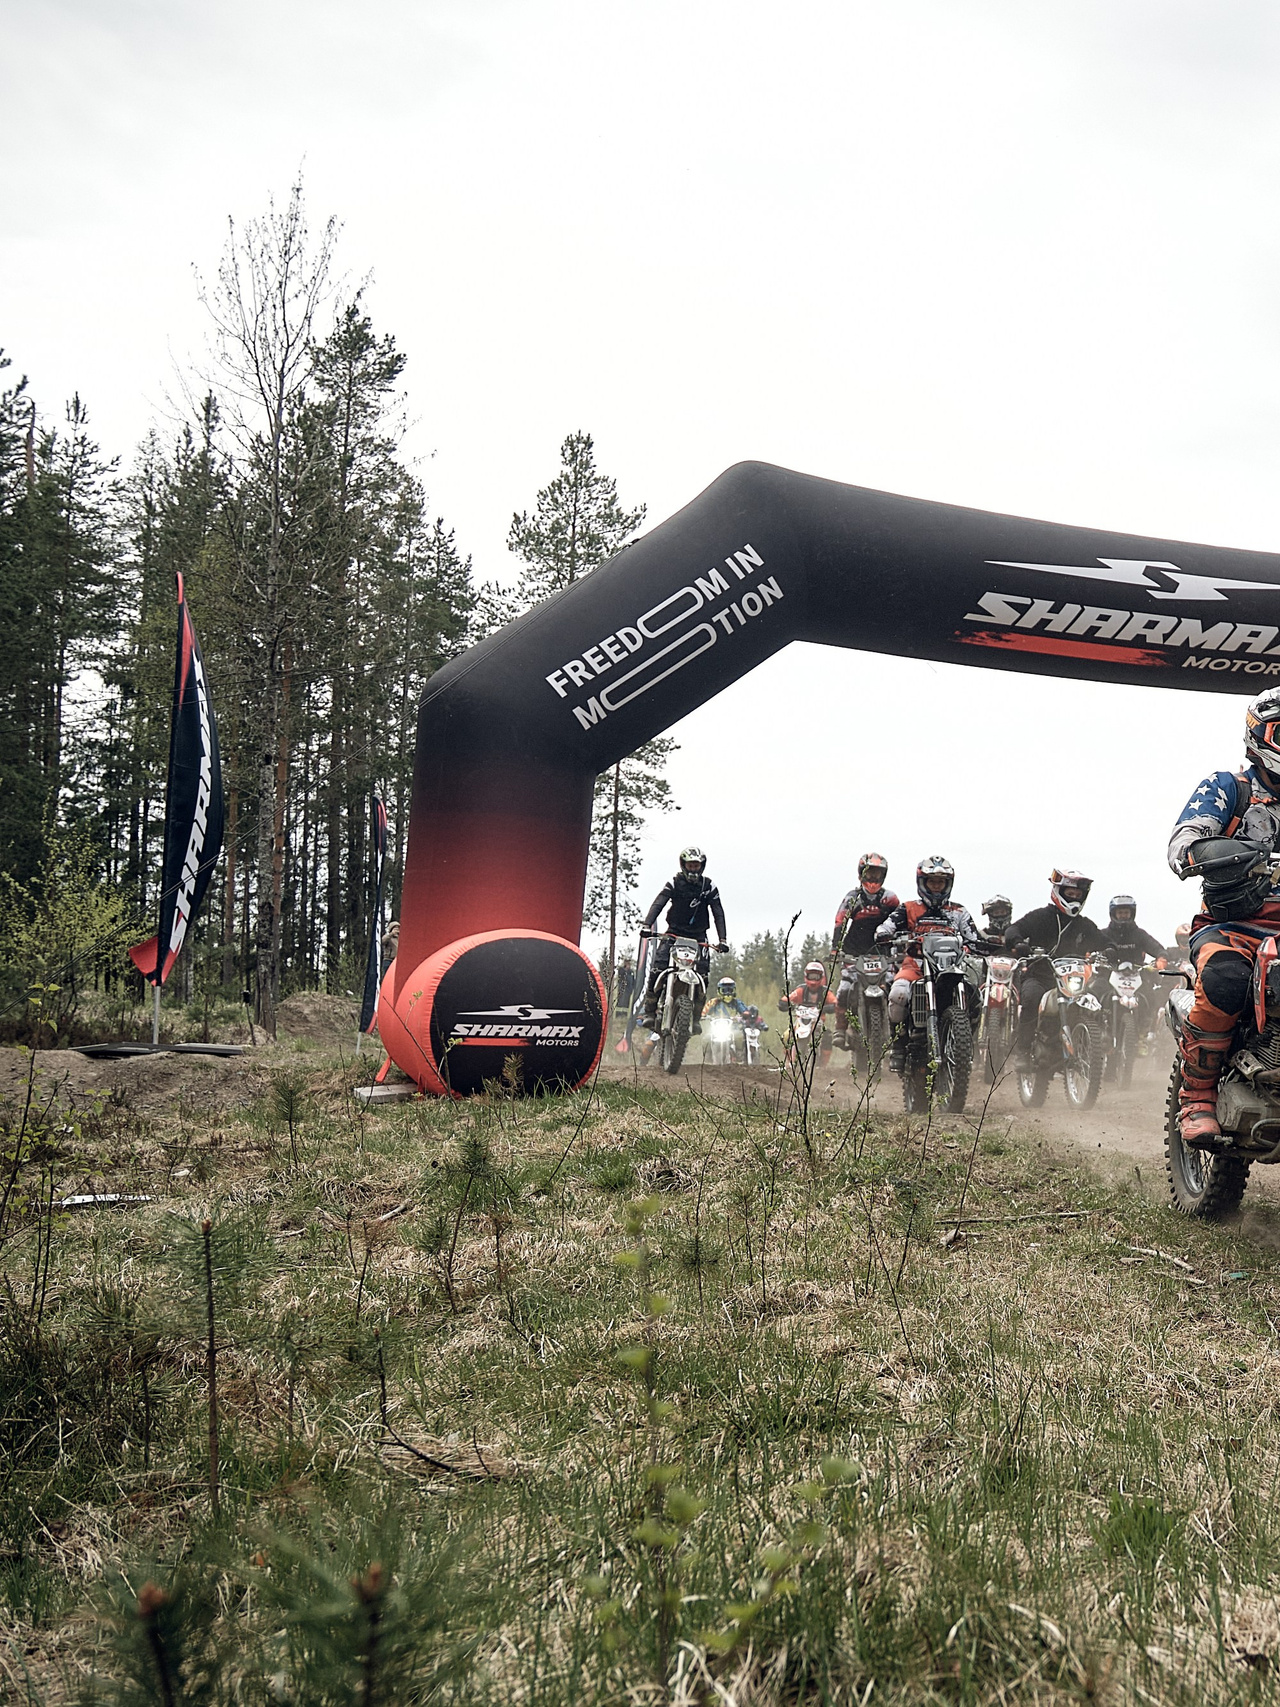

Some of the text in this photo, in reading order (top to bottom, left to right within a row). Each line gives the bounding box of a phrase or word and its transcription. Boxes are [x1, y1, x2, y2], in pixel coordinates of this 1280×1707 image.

[545, 543, 765, 698] FREEDOM IN
[571, 575, 784, 731] MOTION
[169, 647, 212, 958] SHARMAX
[1060, 965, 1072, 974] 37
[450, 1023, 585, 1038] SHARMAX
[535, 1039, 580, 1047] MOTORS
